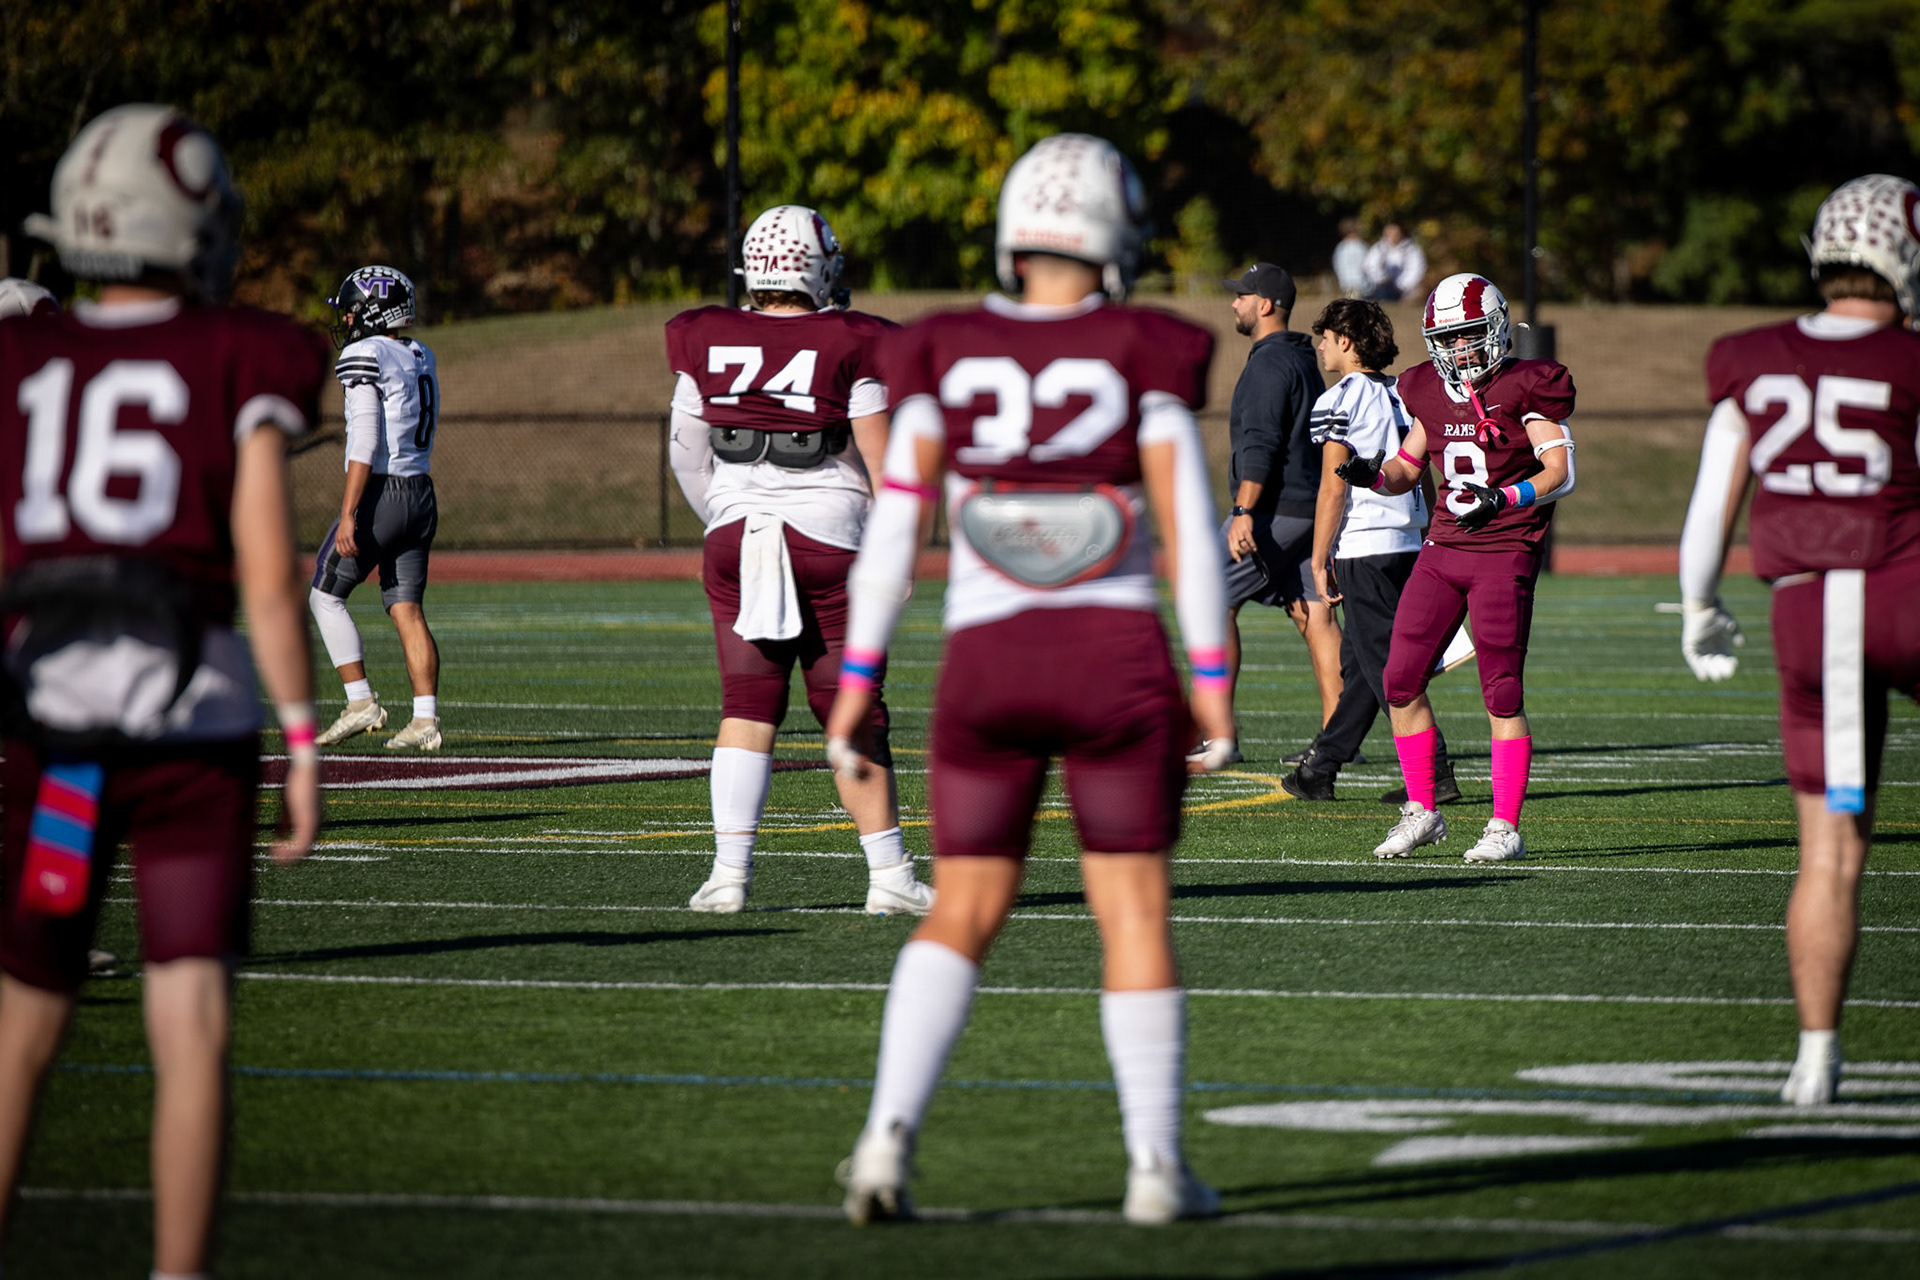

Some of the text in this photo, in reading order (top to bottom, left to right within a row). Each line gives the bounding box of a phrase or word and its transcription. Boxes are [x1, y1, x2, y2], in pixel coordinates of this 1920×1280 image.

[759, 254, 778, 274] 74
[1825, 216, 1859, 241] 25
[354, 276, 395, 299] VT
[415, 373, 435, 451] 8
[707, 346, 818, 414] 74
[939, 356, 1129, 465] 32
[15, 357, 190, 546] 16
[1444, 424, 1476, 436] RAMS
[1744, 374, 1892, 497] 25
[1443, 441, 1489, 516] 8
